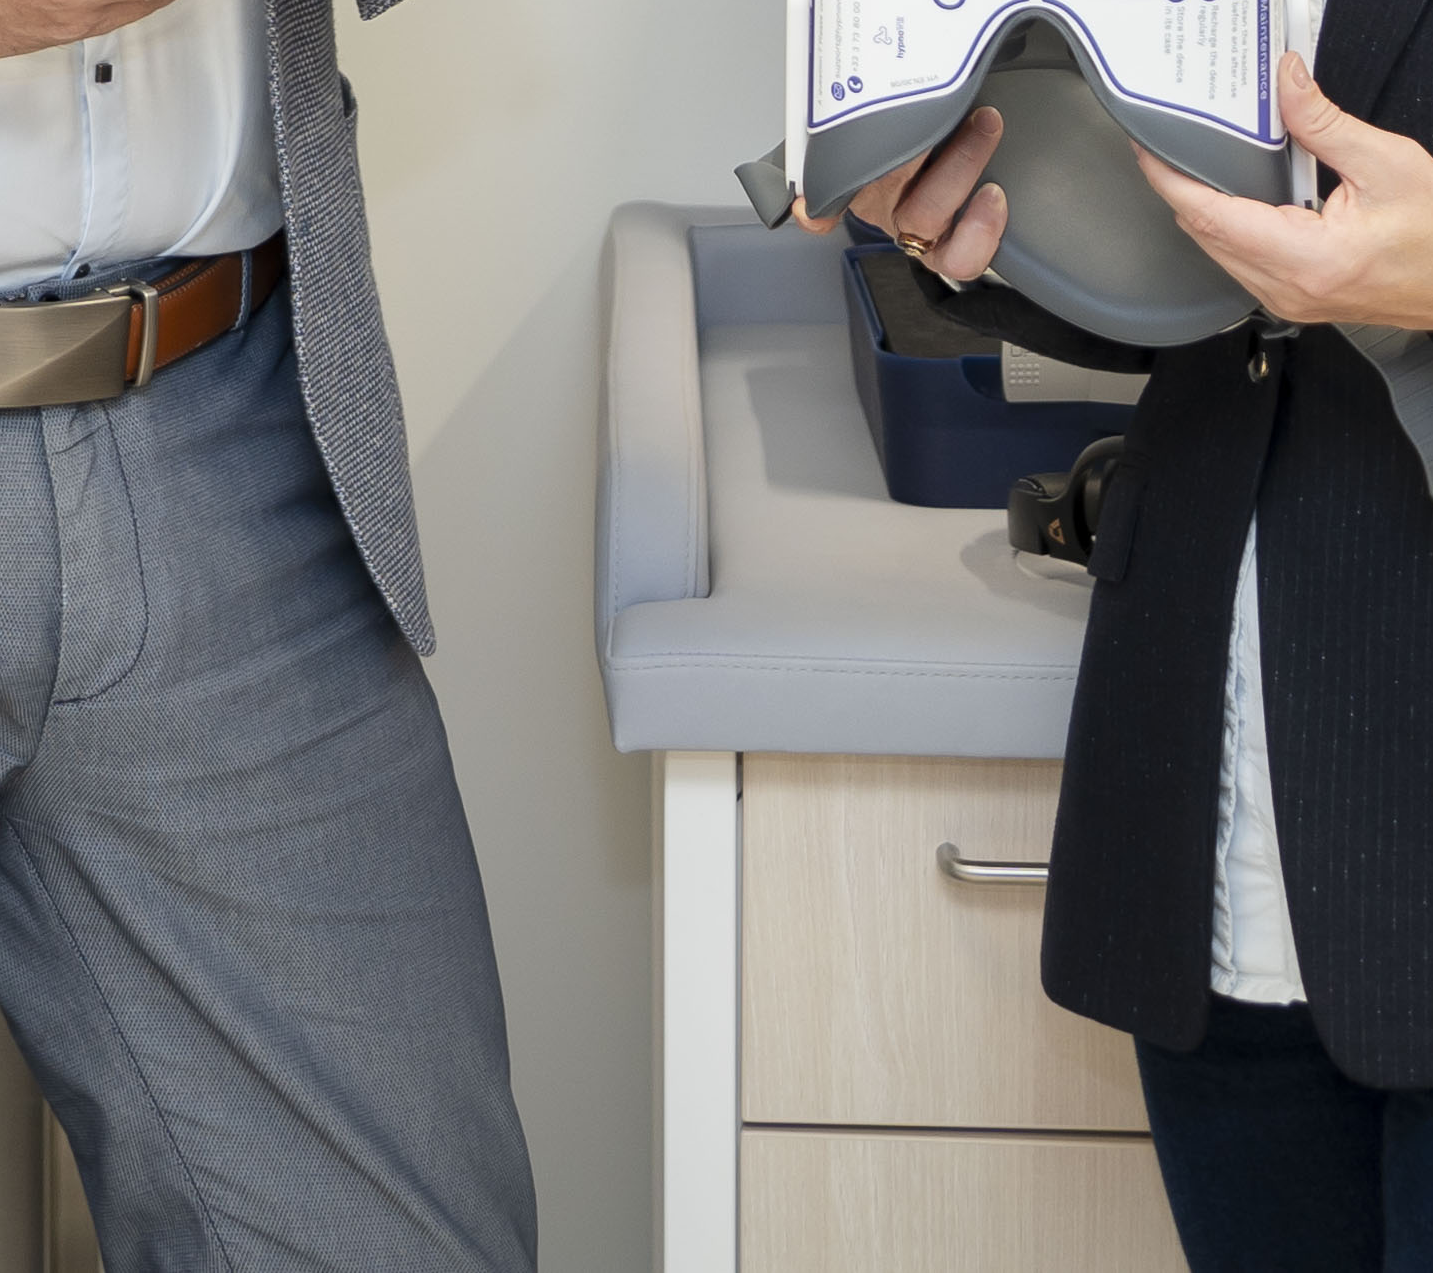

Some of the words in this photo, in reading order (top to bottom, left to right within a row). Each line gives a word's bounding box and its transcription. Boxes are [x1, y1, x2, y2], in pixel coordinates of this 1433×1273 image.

[1176, 6, 1185, 33] Store
[1197, 6, 1207, 47] regularly
[1209, 4, 1219, 49] Recharge
[1231, 1, 1239, 33] before
[1241, 0, 1249, 27] Clean
[1164, 33, 1172, 55] case
[1176, 34, 1185, 50] the
[1230, 36, 1239, 53] and
[1175, 53, 1184, 83] device
[1209, 51, 1218, 67] the
[1230, 56, 1239, 78] after
[1240, 48, 1248, 86] headset
[1208, 70, 1217, 101] device
